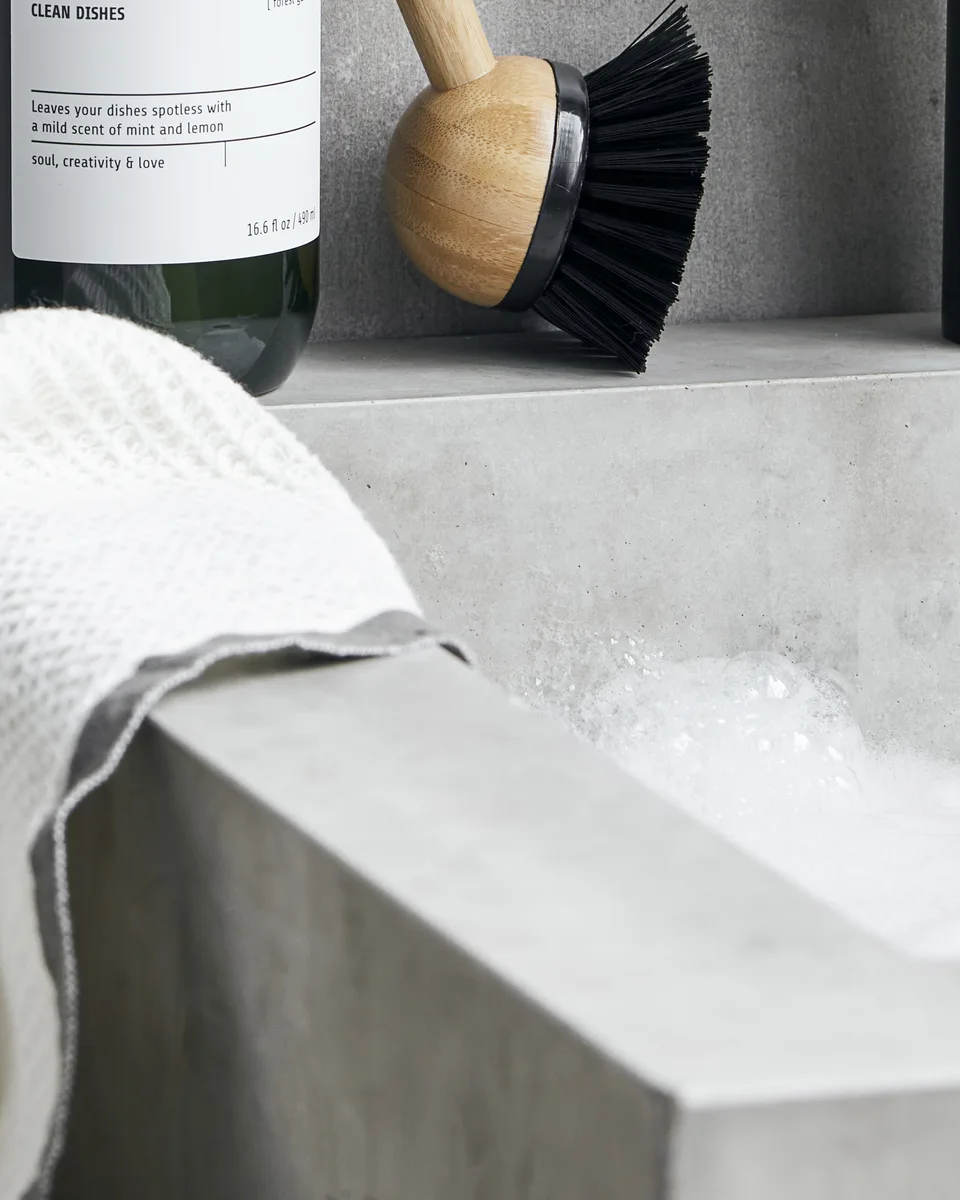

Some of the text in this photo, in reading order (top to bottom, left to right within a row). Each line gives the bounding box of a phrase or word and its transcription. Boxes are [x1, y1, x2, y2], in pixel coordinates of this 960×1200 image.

[31, 3, 125, 20] CLEAN DISHES
[31, 100, 232, 118] Leaves your dishes spotless with
[31, 121, 224, 135] a mild scent of mint and lemon
[31, 154, 165, 171] soul, creativity & love
[247, 221, 269, 237] 16.6
[271, 218, 278, 232] fl
[280, 218, 291, 231] oz
[298, 209, 309, 225] 490
